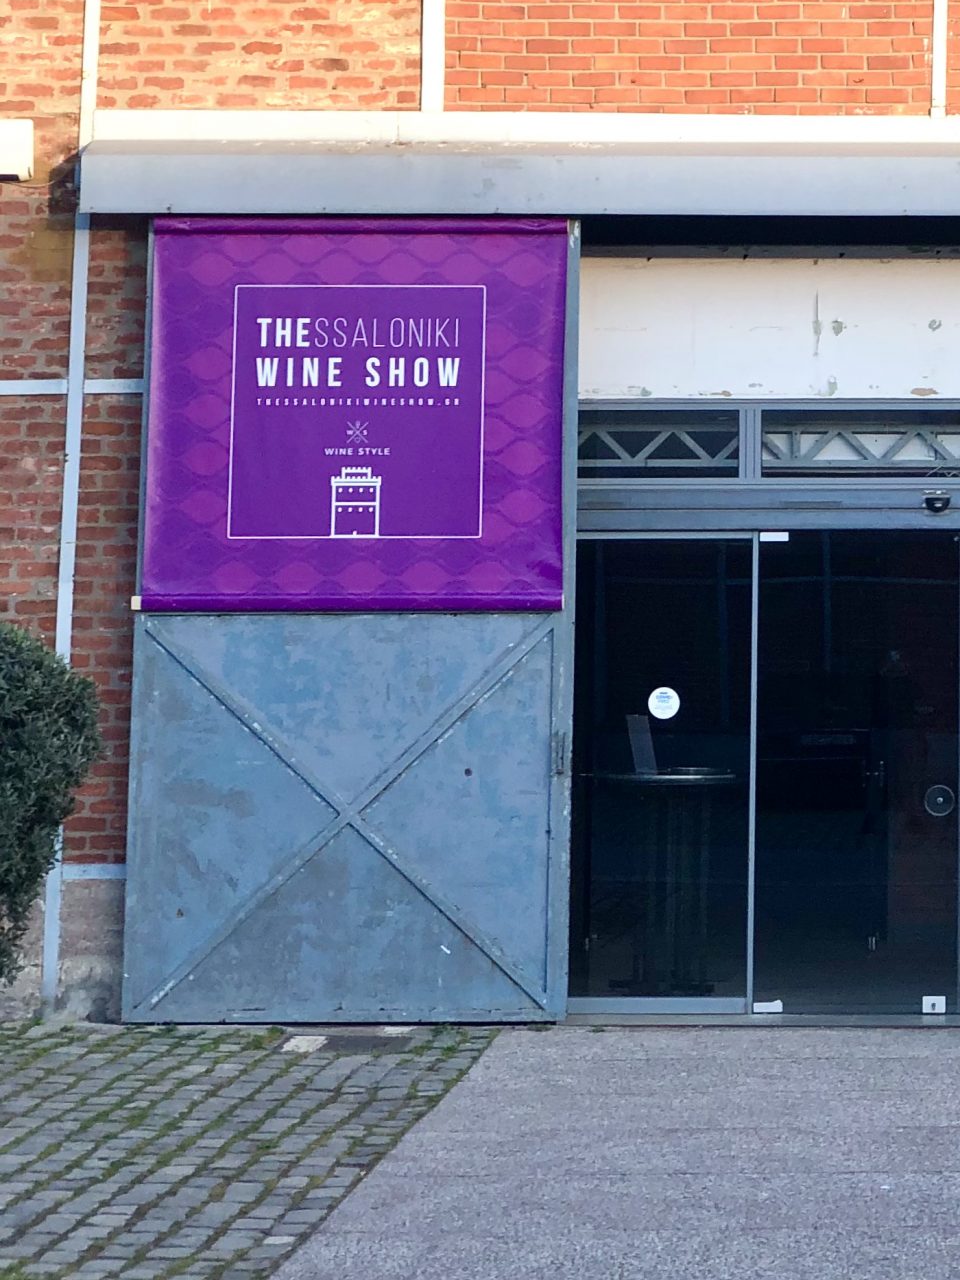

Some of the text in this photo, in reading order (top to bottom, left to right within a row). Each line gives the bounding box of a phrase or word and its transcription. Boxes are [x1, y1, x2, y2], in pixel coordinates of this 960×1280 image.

[256, 317, 460, 348] THESSALONIKI
[255, 356, 461, 388] WINE SHOW
[324, 447, 391, 456] WINE STYLE
